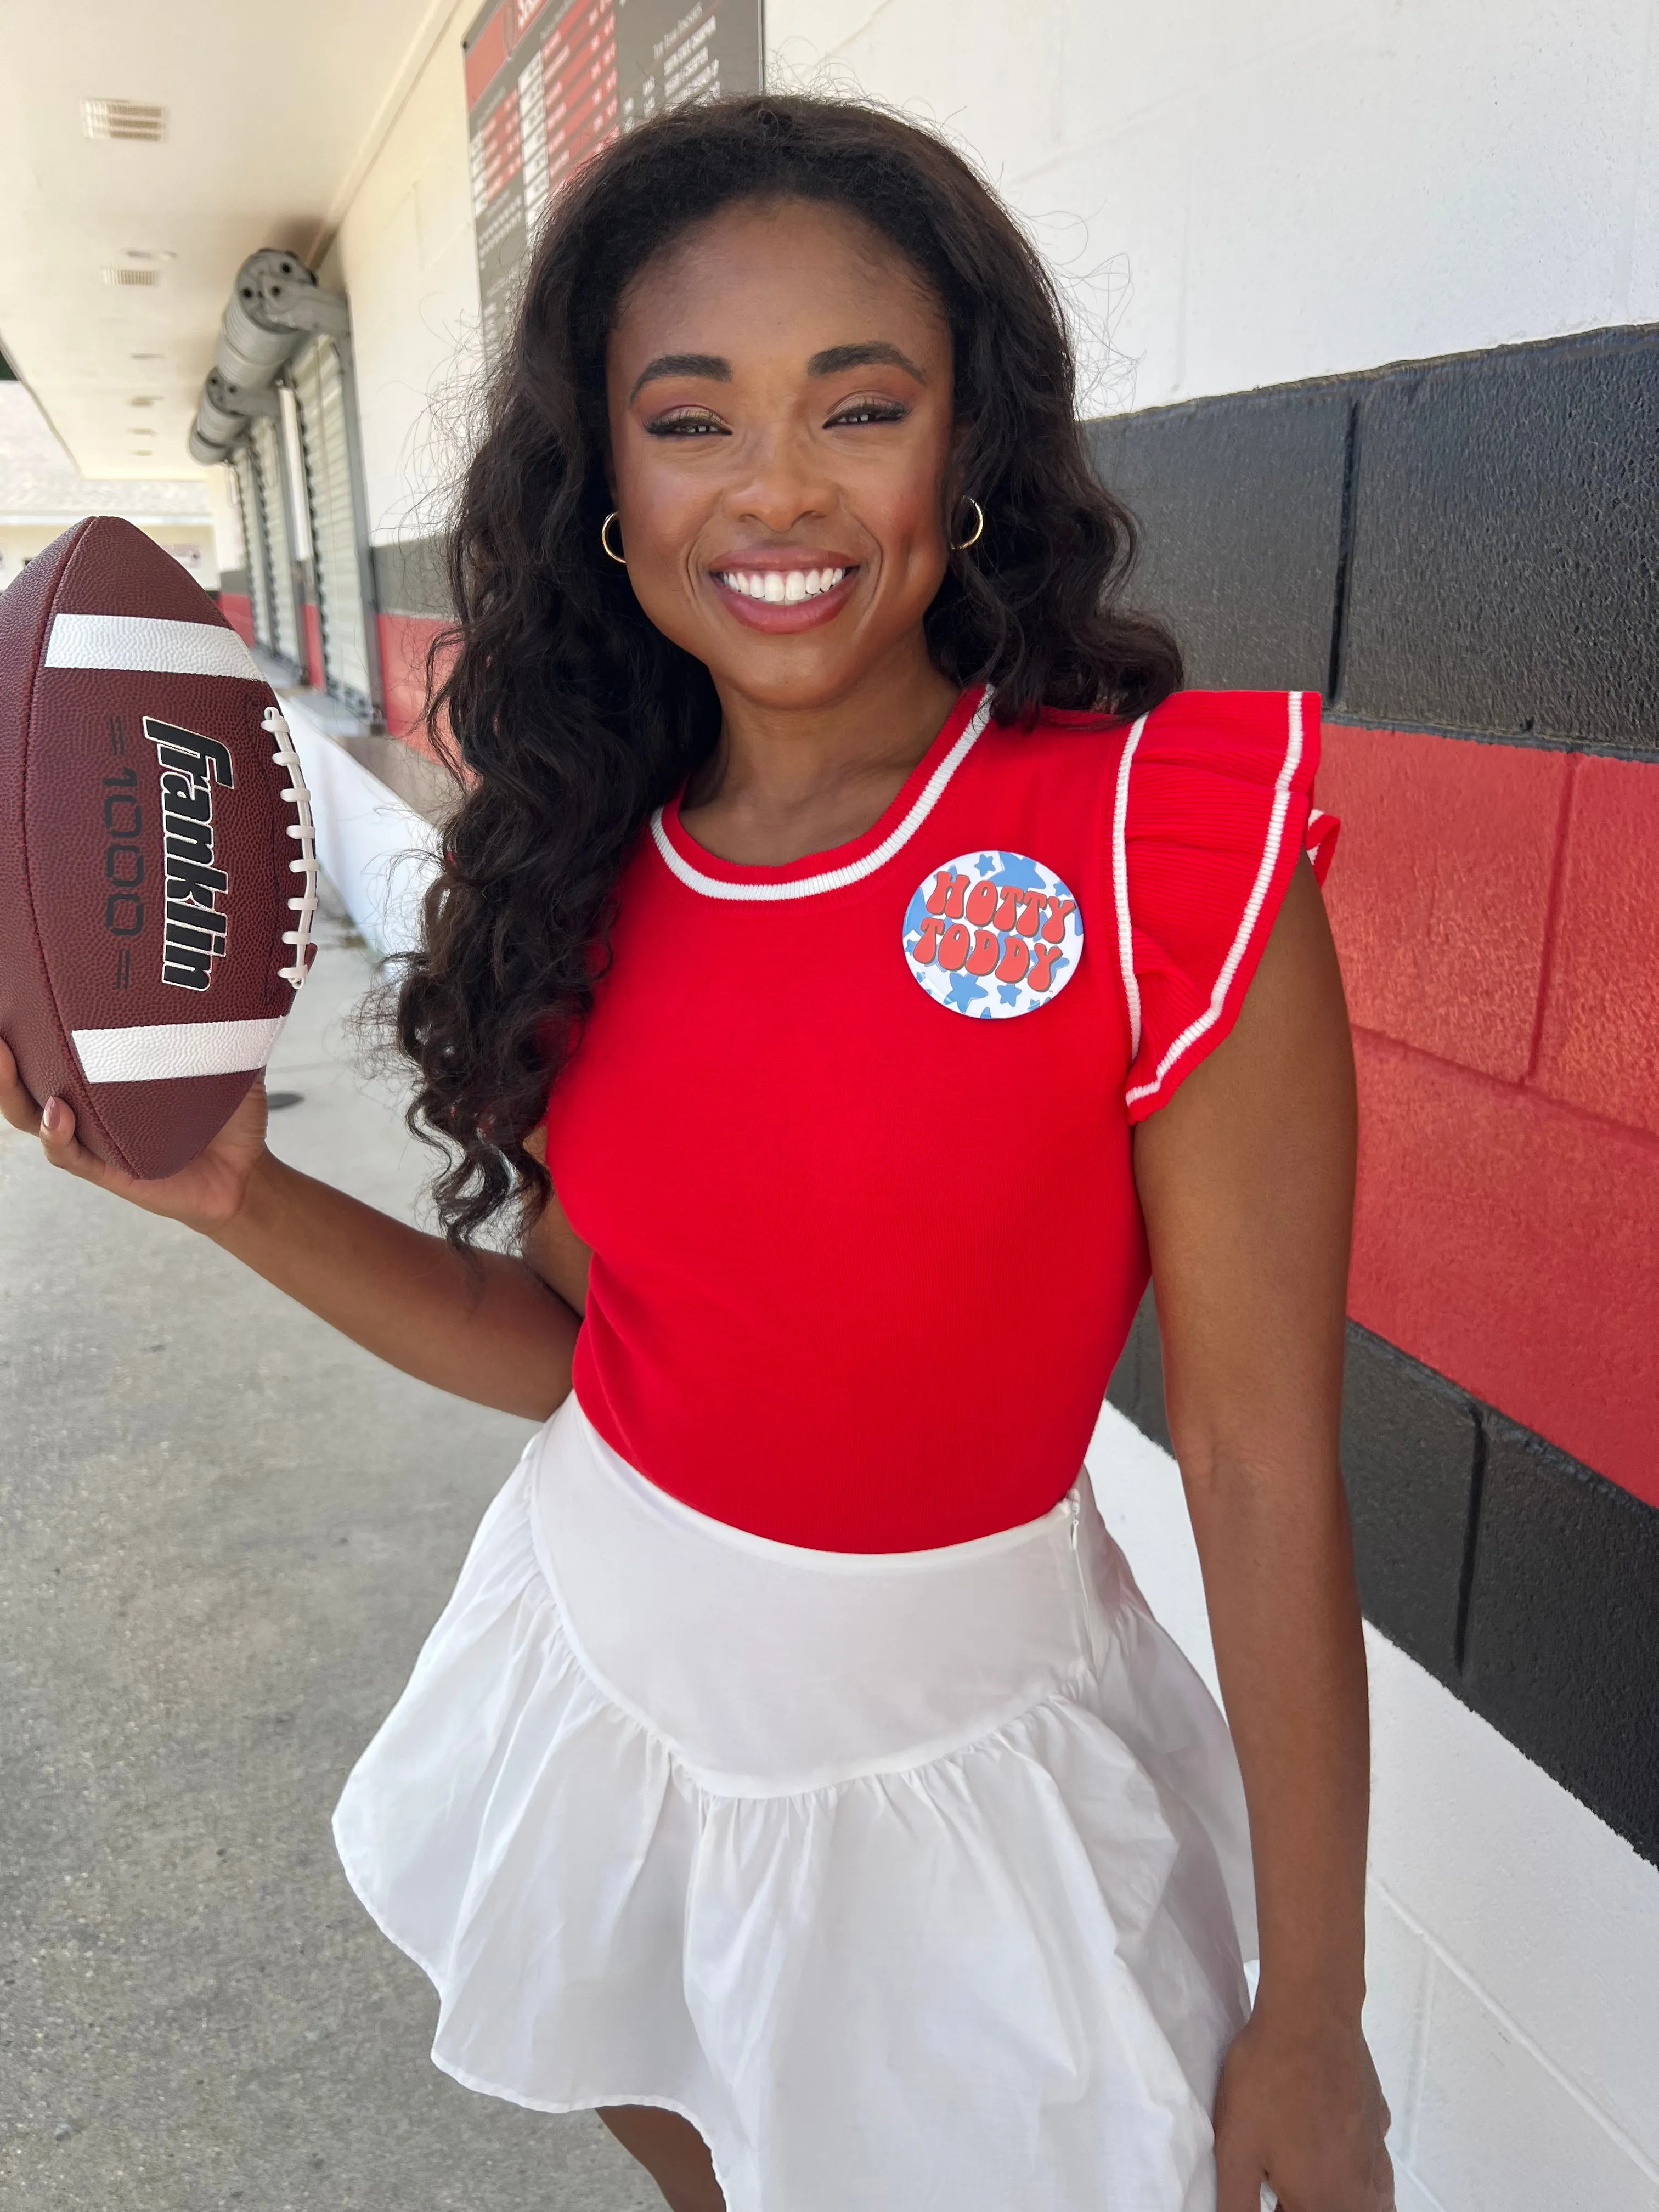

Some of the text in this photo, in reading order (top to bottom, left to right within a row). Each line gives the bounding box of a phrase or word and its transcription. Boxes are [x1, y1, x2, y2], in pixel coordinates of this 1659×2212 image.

[103, 766, 144, 936] 1000
[926, 871, 1076, 944] HOTTY
[913, 916, 1063, 993] TODDY
